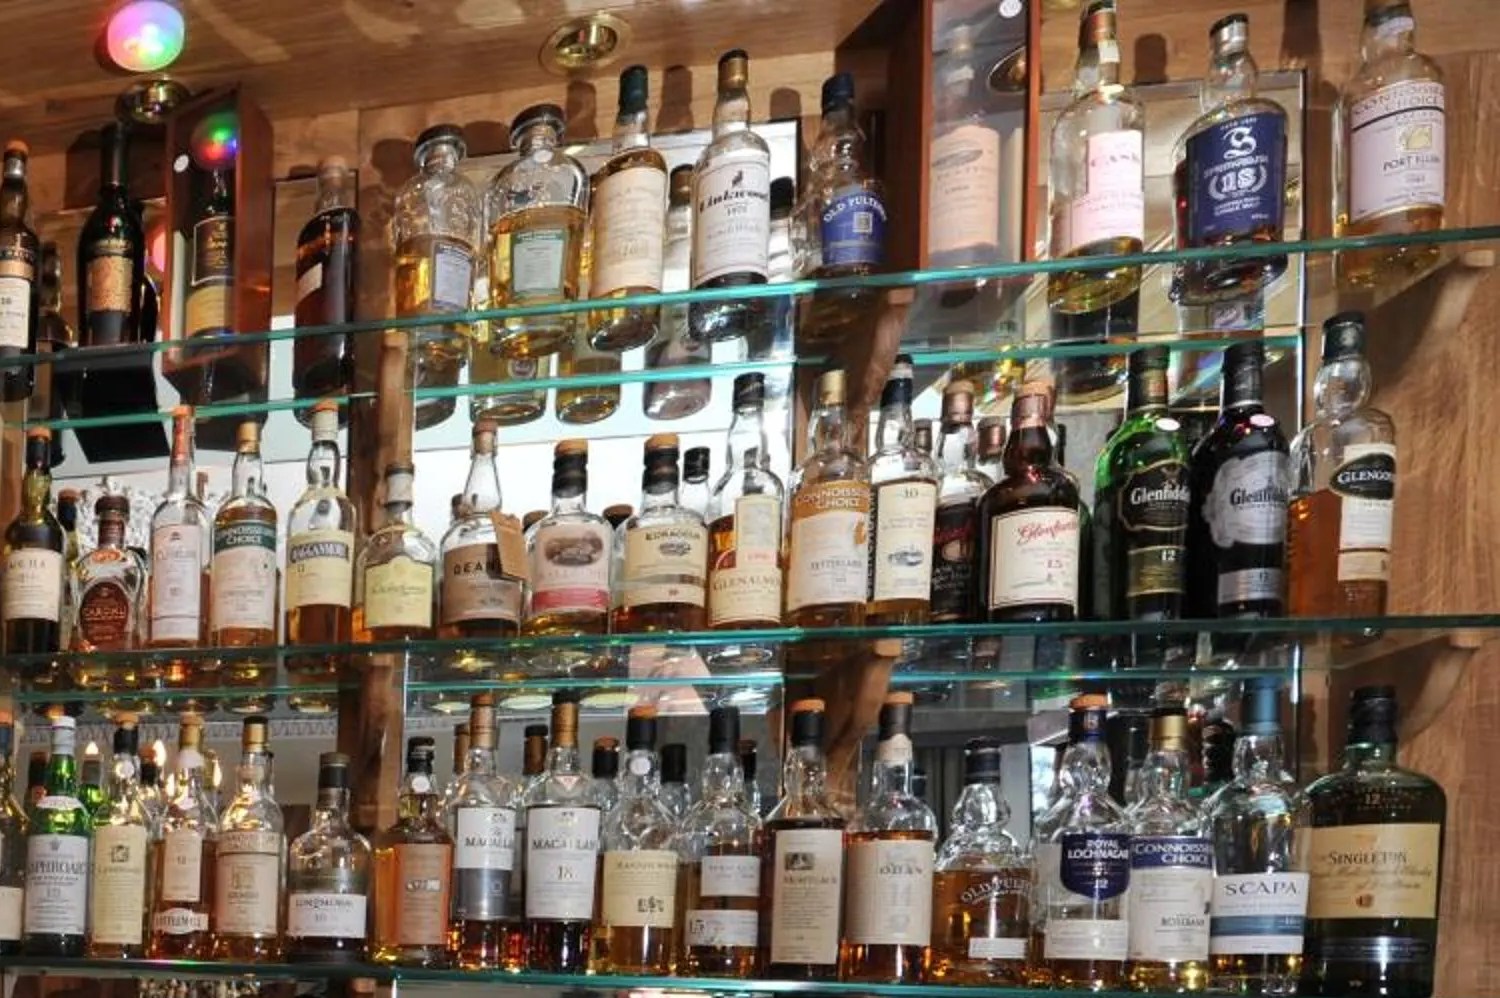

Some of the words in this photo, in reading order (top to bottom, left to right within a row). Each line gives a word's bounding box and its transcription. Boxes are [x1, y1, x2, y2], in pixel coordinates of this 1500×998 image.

[823, 203, 846, 223] OLD
[1337, 470, 1393, 483] GLENGO
[1130, 485, 1191, 505] Glenfidd
[1223, 880, 1300, 897] SCAPA
